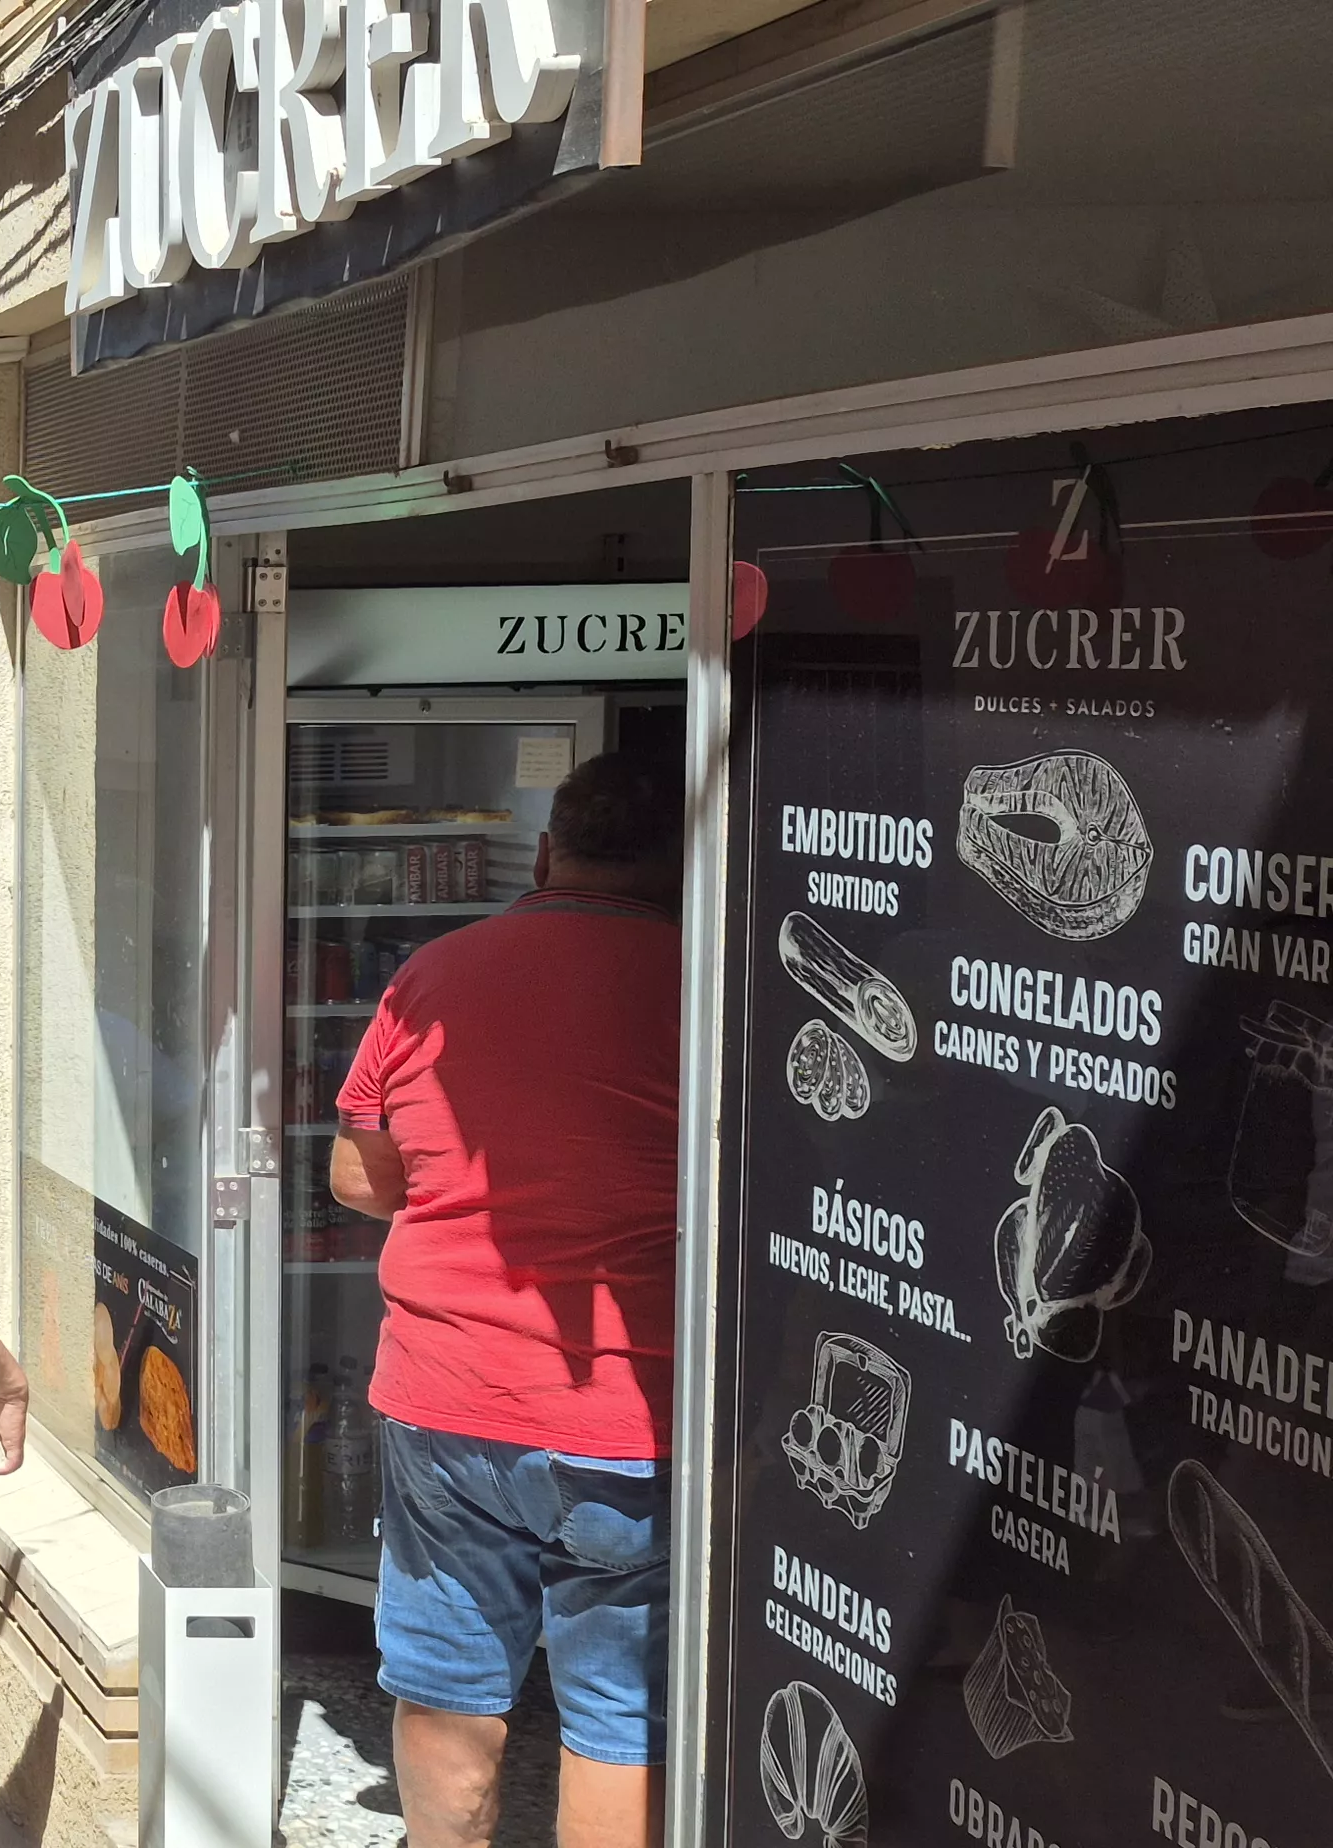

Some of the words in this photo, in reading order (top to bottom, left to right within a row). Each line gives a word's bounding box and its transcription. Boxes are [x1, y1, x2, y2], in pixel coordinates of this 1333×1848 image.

[497, 613, 686, 655] ZUCRE
[952, 607, 1188, 672] ZUCRER
[974, 695, 1042, 714] DULCES
[1066, 698, 1155, 718] SALADOS
[781, 804, 933, 869] EMBUTIDOS
[409, 855, 423, 902] AMBAR
[807, 874, 900, 917] SURTIDOS
[1183, 921, 1261, 973] GRAN
[1272, 933, 1330, 984] VAR
[950, 955, 1163, 1046] CONGELADOS
[934, 1020, 1019, 1073] CARNES
[1028, 1041, 1043, 1077] Y
[1049, 1047, 1177, 1109] PESCADOS
[811, 1179, 925, 1269] BÁSICOS
[769, 1231, 834, 1290] HUEVOS,
[839, 1257, 894, 1316] LECHE,
[1188, 1385, 1333, 1478] TRADICION
[949, 1417, 1121, 1544] PASTELERÍA
[991, 1504, 1071, 1576] CASERA
[773, 1545, 892, 1654] BANDEJAS
[765, 1599, 898, 1707] CELEBRACIONES
